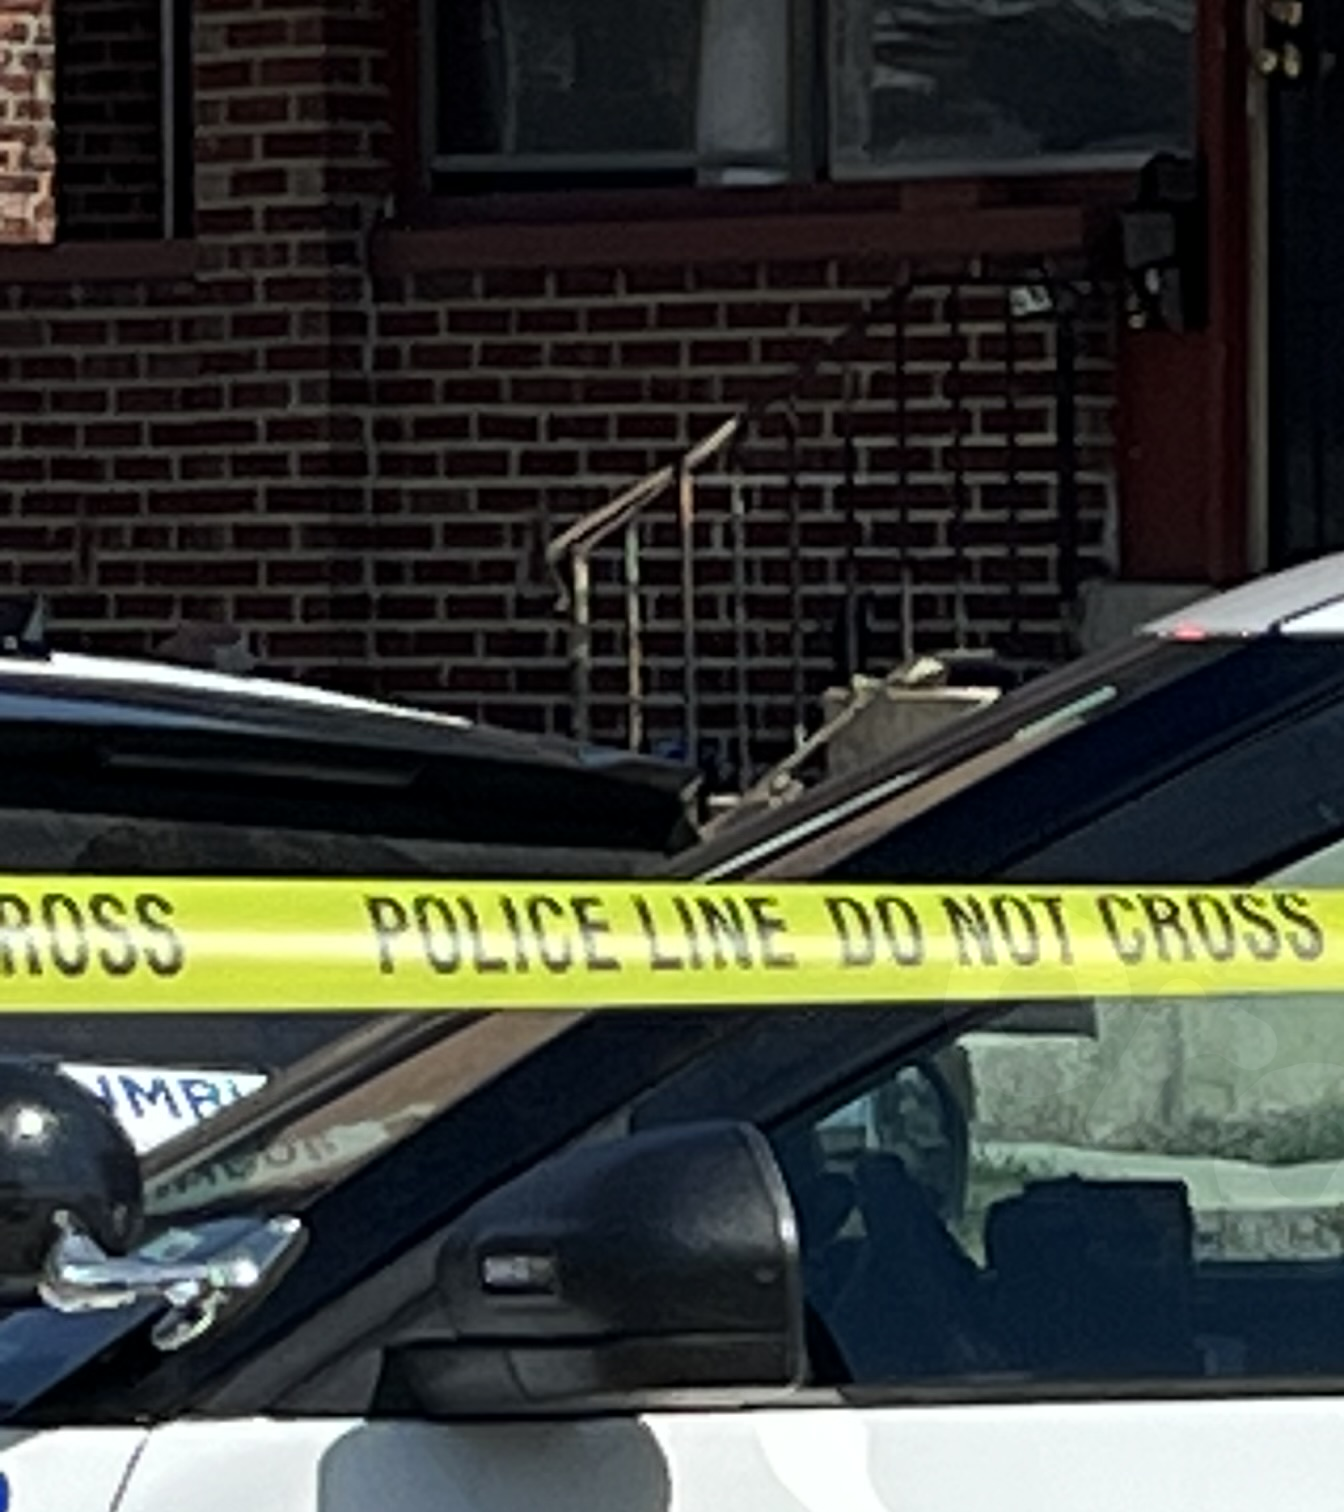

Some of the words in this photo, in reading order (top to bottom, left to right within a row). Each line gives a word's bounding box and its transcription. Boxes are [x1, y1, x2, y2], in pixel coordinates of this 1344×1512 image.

[366, 895, 623, 974] POLICE
[631, 895, 798, 971] LINE
[824, 896, 926, 968] DO
[939, 895, 1076, 967] NOT
[1097, 893, 1325, 965] CROSS
